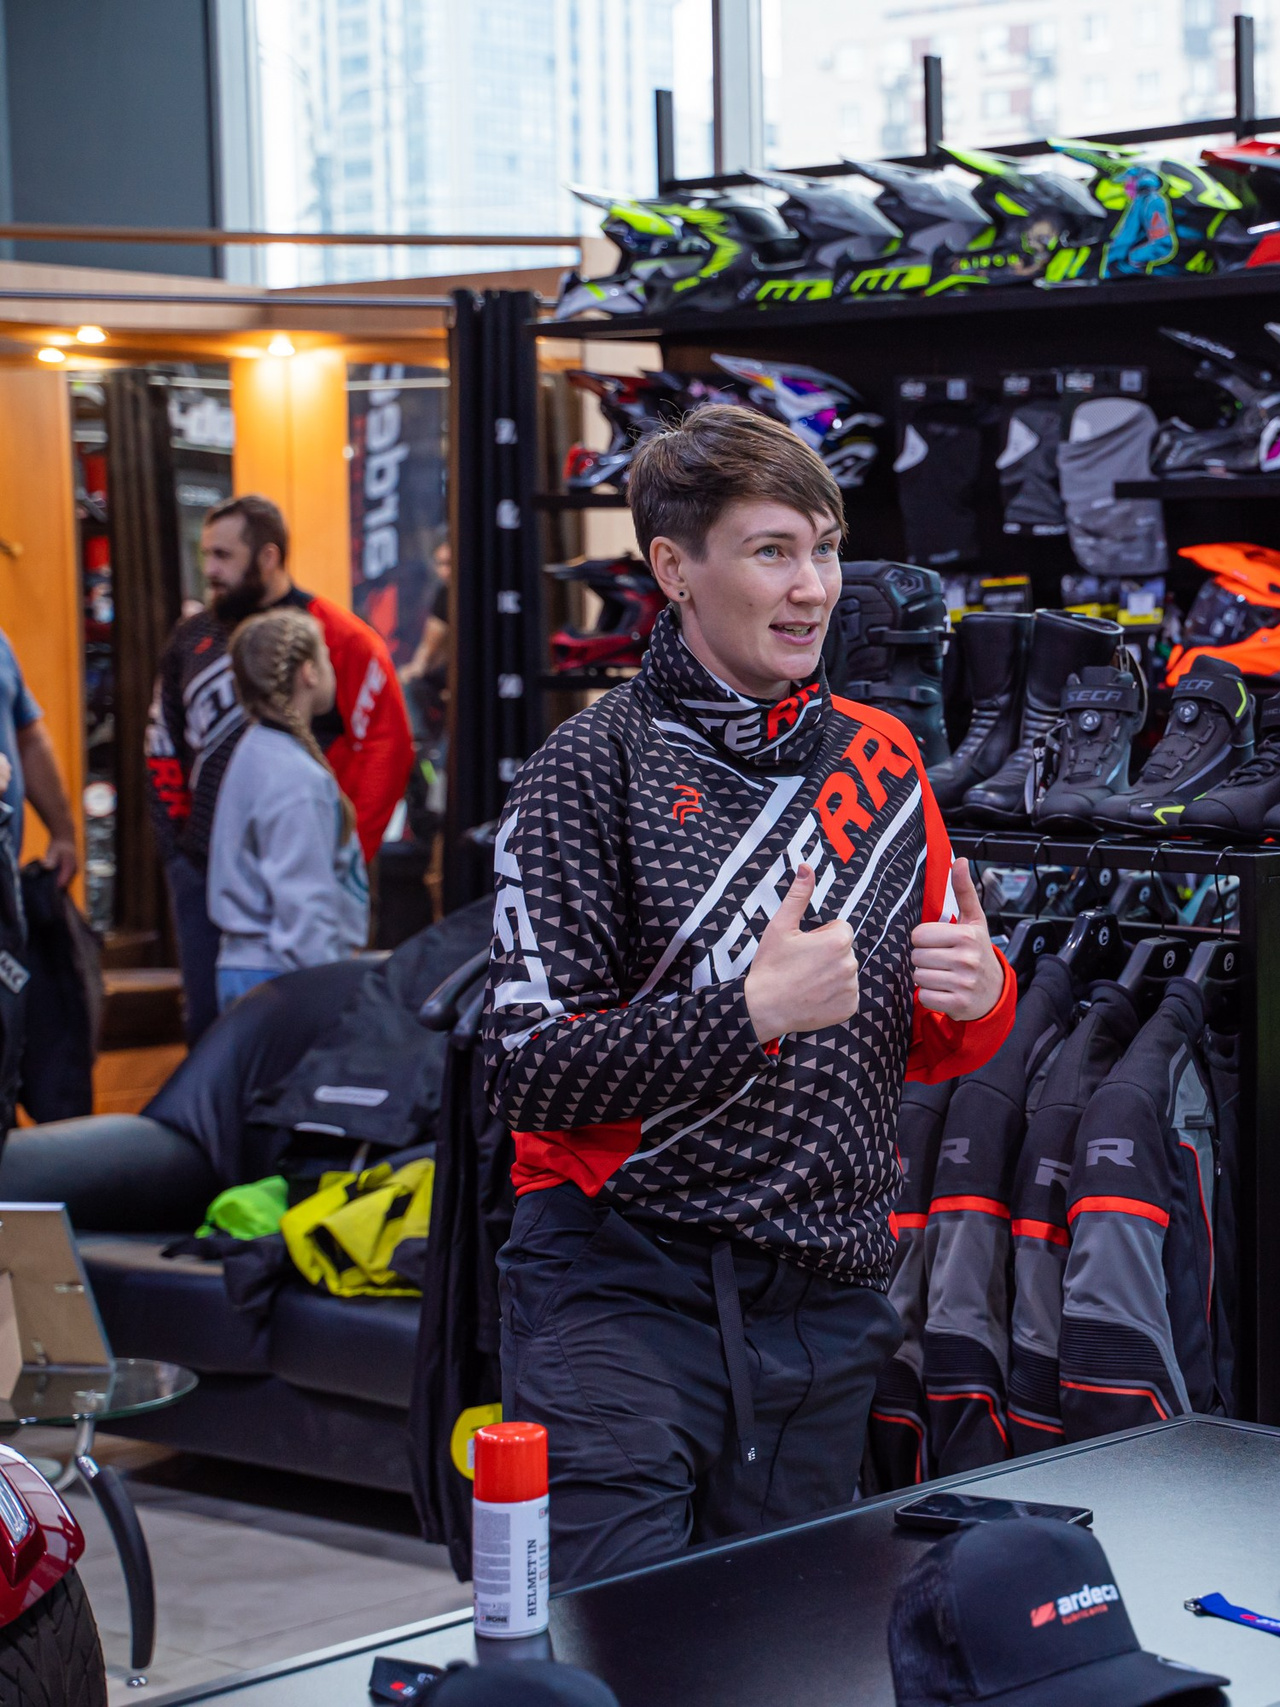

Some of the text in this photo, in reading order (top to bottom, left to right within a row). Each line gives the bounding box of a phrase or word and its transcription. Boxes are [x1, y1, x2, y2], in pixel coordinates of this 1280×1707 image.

[1175, 678, 1215, 692] ECA
[1066, 690, 1122, 702] SECA
[527, 1539, 537, 1617] HELMET'IN
